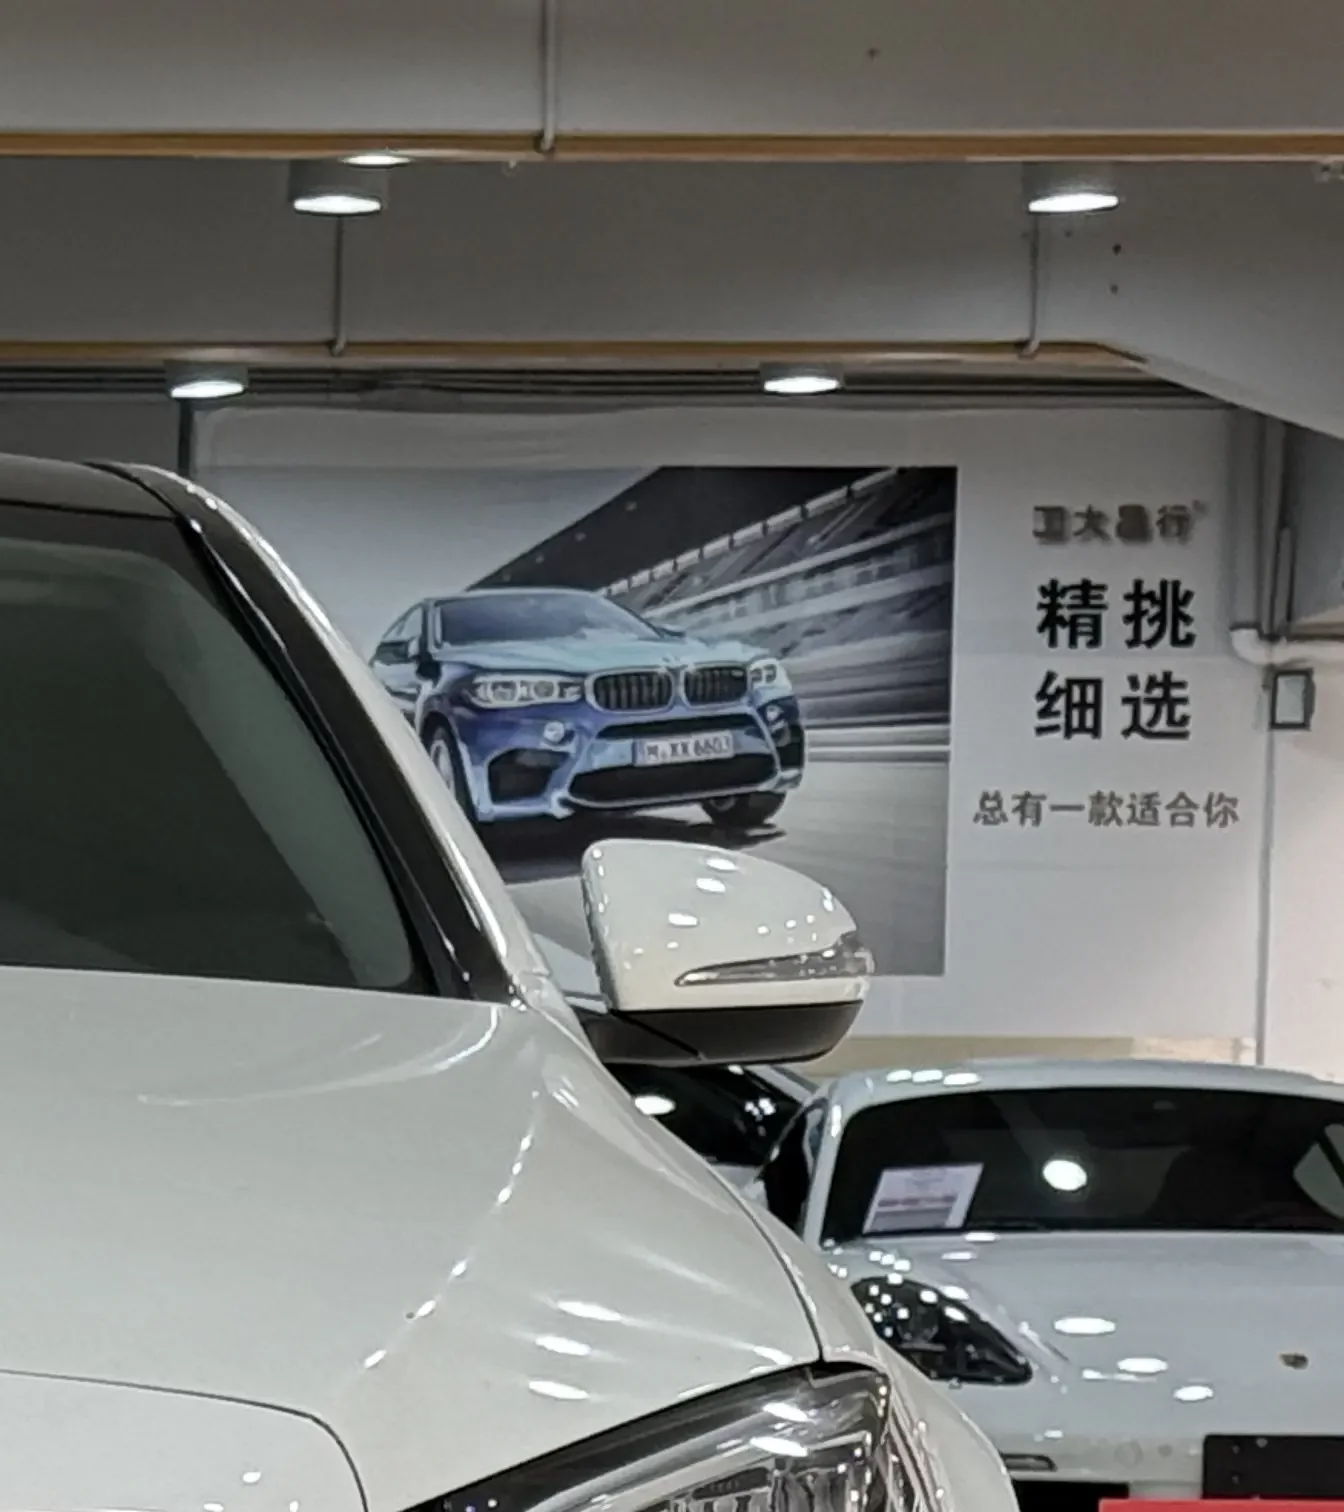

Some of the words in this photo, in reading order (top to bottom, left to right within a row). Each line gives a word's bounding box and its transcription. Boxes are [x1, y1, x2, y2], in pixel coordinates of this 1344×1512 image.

[1073, 503, 1194, 545] 大昌行
[1035, 578, 1197, 649] 精挑
[1034, 671, 1193, 741] 细选
[972, 791, 1240, 828] 总有一款适合你
